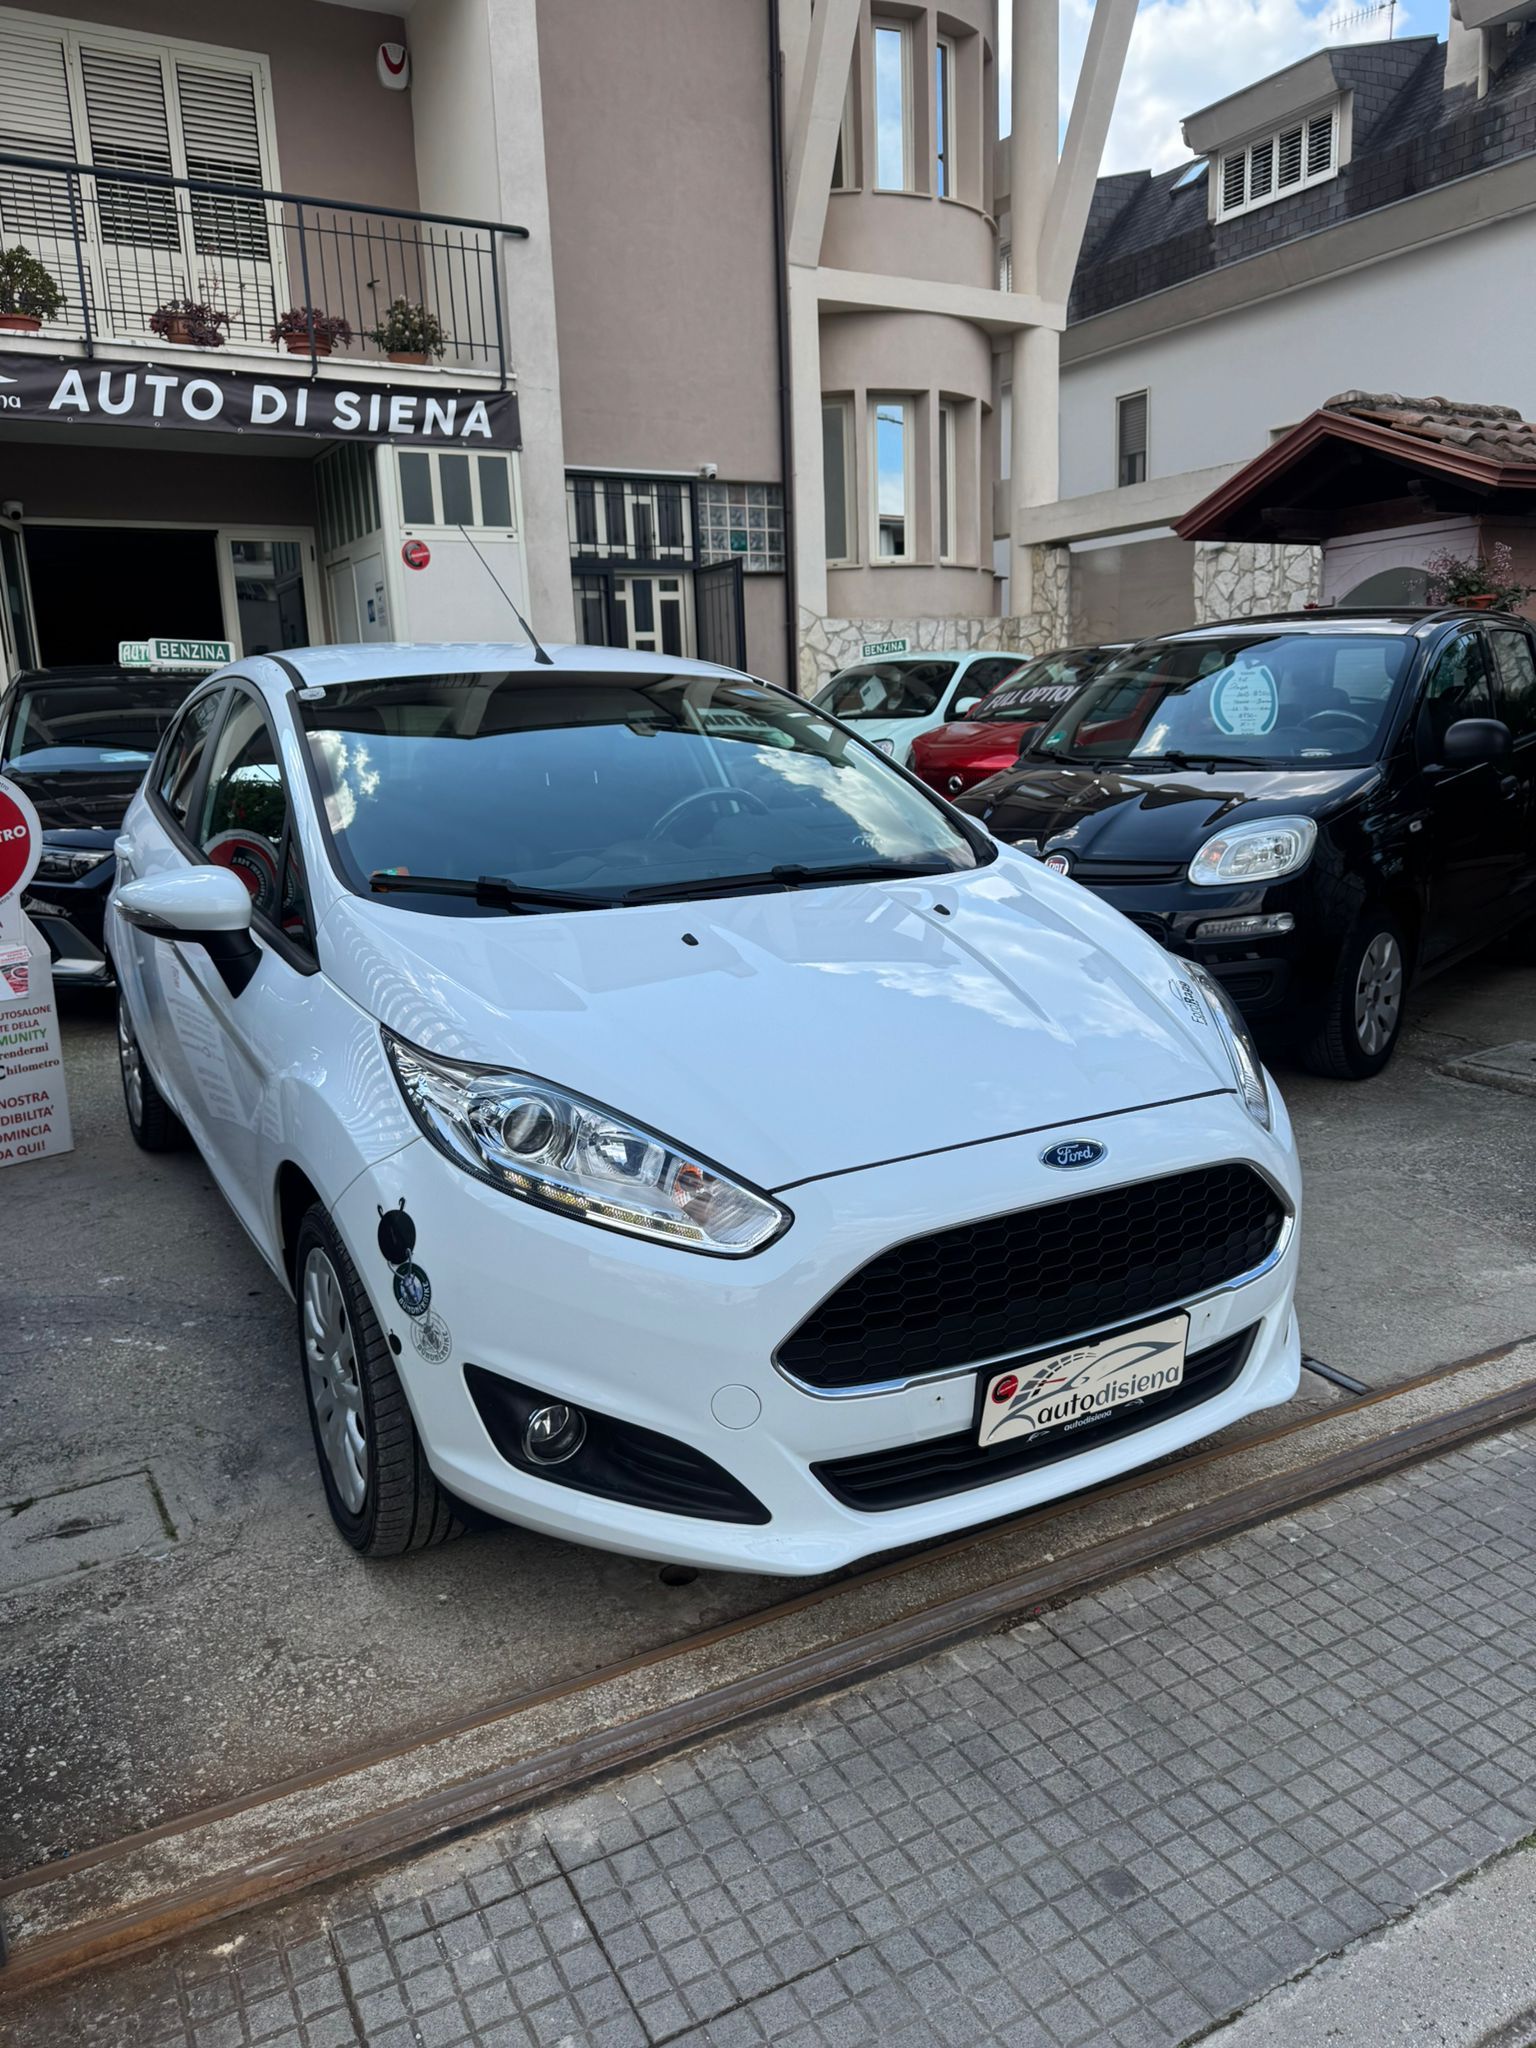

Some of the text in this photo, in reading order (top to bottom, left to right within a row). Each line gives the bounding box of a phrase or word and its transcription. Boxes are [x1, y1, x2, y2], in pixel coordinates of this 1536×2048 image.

[48, 368, 493, 438] AUTO DI SIENA
[160, 642, 226, 660] BENZINA
[864, 641, 904, 656] BENZINA
[11, 1019, 40, 1031] DELLA
[0, 1090, 50, 1110] NOSTRA
[17, 1140, 46, 1156] QUI!
[1056, 1143, 1094, 1165] Ford
[1037, 1365, 1180, 1425] autodisiena
[1064, 1409, 1112, 1432] autodisiena
